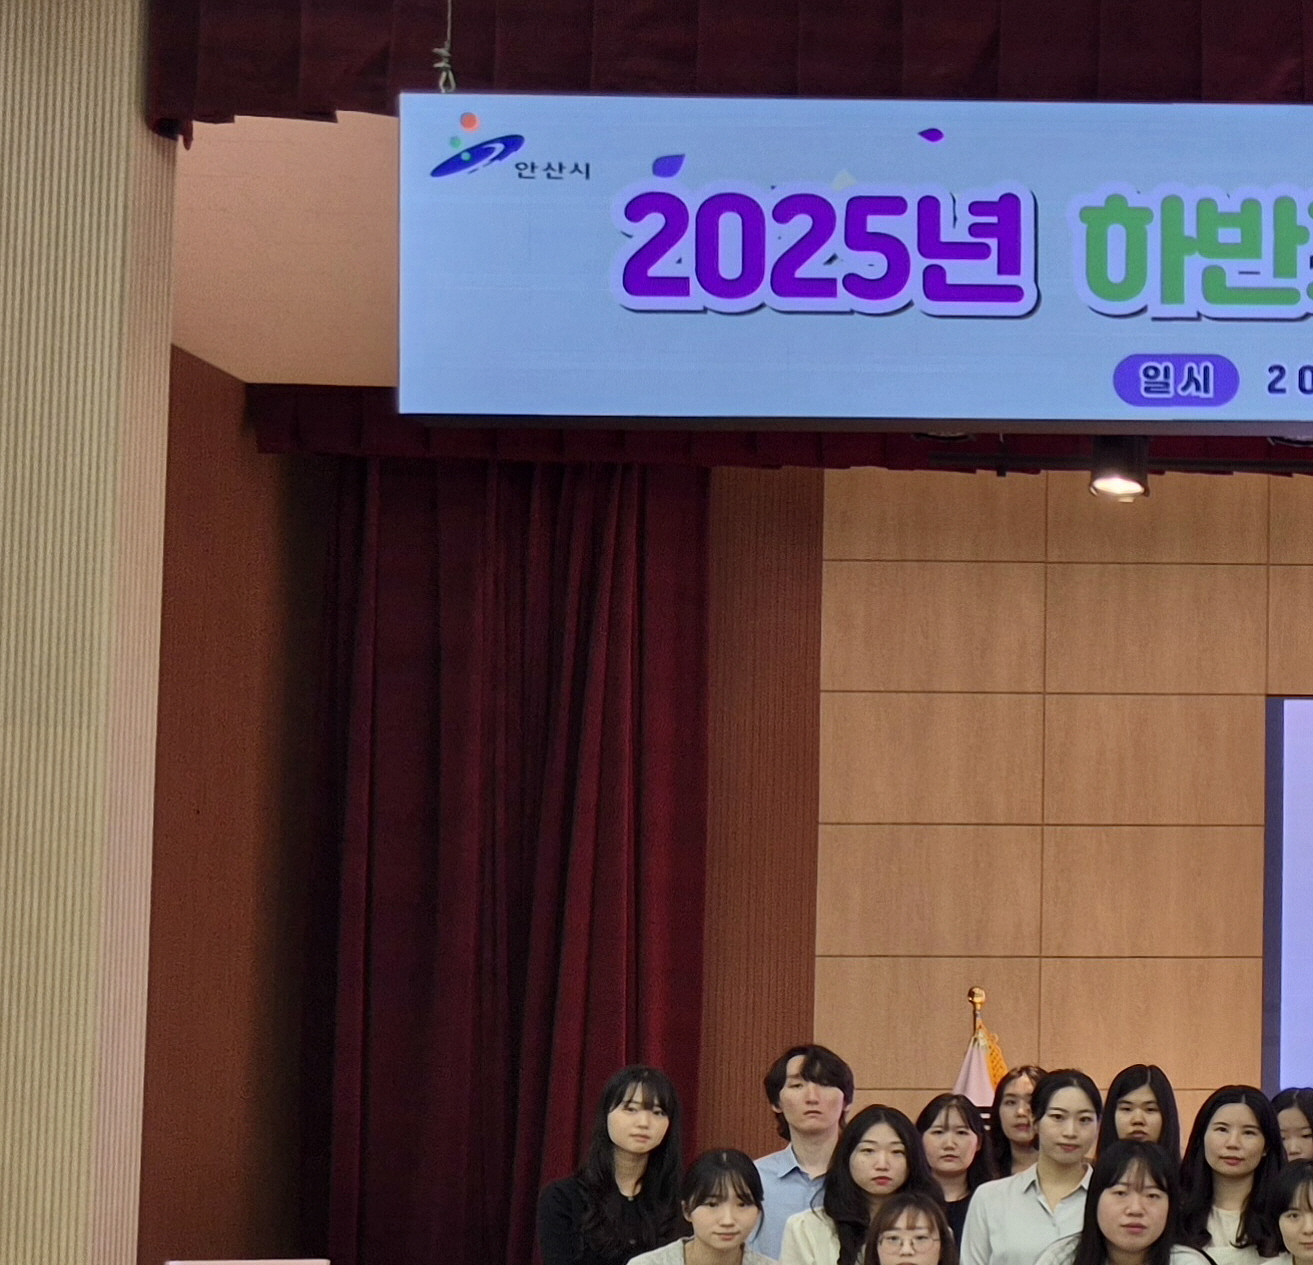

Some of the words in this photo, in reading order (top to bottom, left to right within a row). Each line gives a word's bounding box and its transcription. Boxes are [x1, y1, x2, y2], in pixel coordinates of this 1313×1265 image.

[515, 162, 591, 180] 안산시
[620, 190, 1025, 302] 2025년
[1140, 364, 1215, 398] 일시
